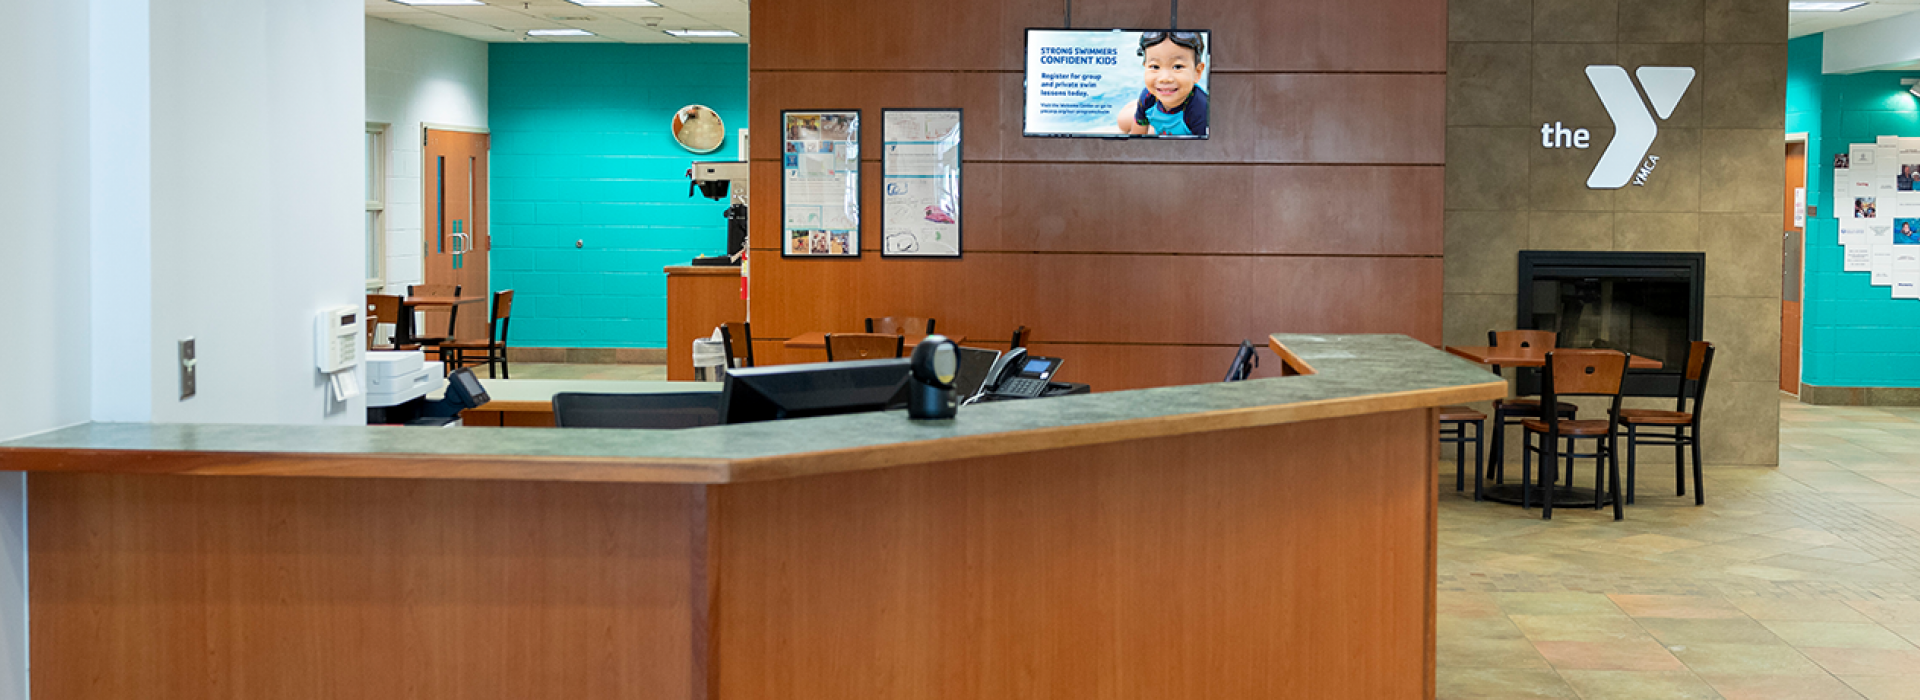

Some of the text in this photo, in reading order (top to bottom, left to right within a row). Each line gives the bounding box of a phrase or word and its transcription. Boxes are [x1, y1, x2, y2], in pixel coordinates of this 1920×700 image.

[1040, 47, 1117, 55] STRONG SWIMMERS
[1040, 56, 1117, 65] CONFIDENT KIDS
[1541, 121, 1590, 149] the
[1632, 154, 1661, 187] YMCA
